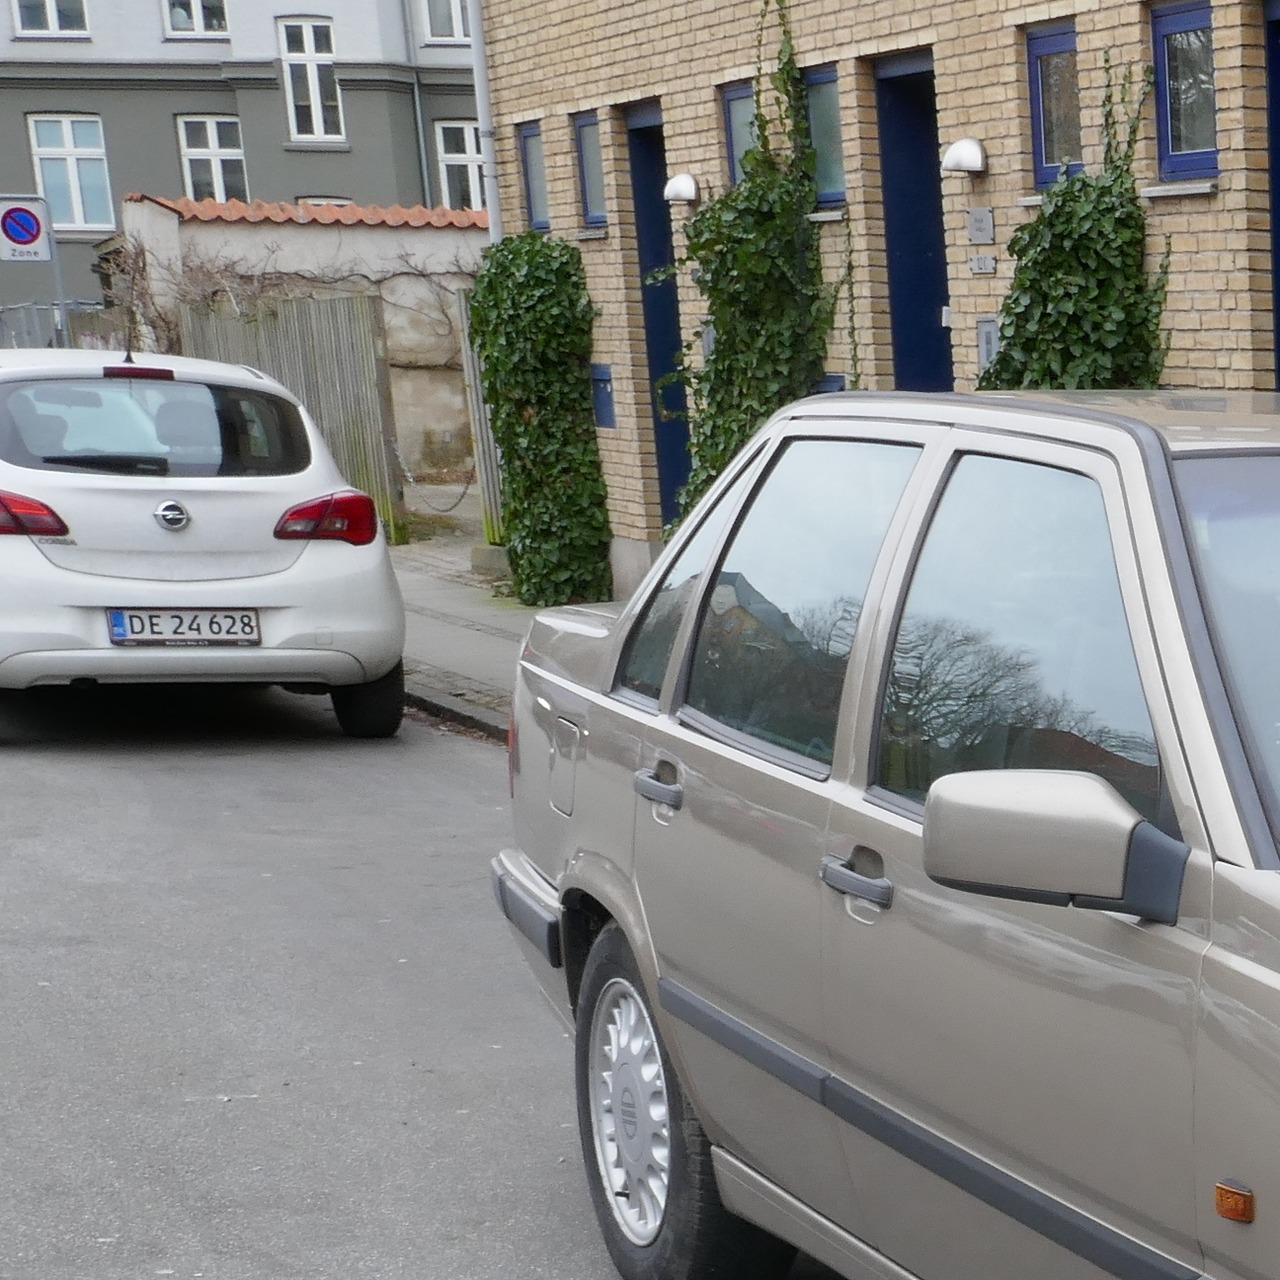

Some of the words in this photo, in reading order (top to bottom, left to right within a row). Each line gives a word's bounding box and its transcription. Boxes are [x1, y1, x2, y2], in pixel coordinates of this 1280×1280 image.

[11, 248, 39, 257] Zone
[129, 614, 163, 635] DE
[171, 614, 202, 635] 24
[209, 613, 255, 636] 628
